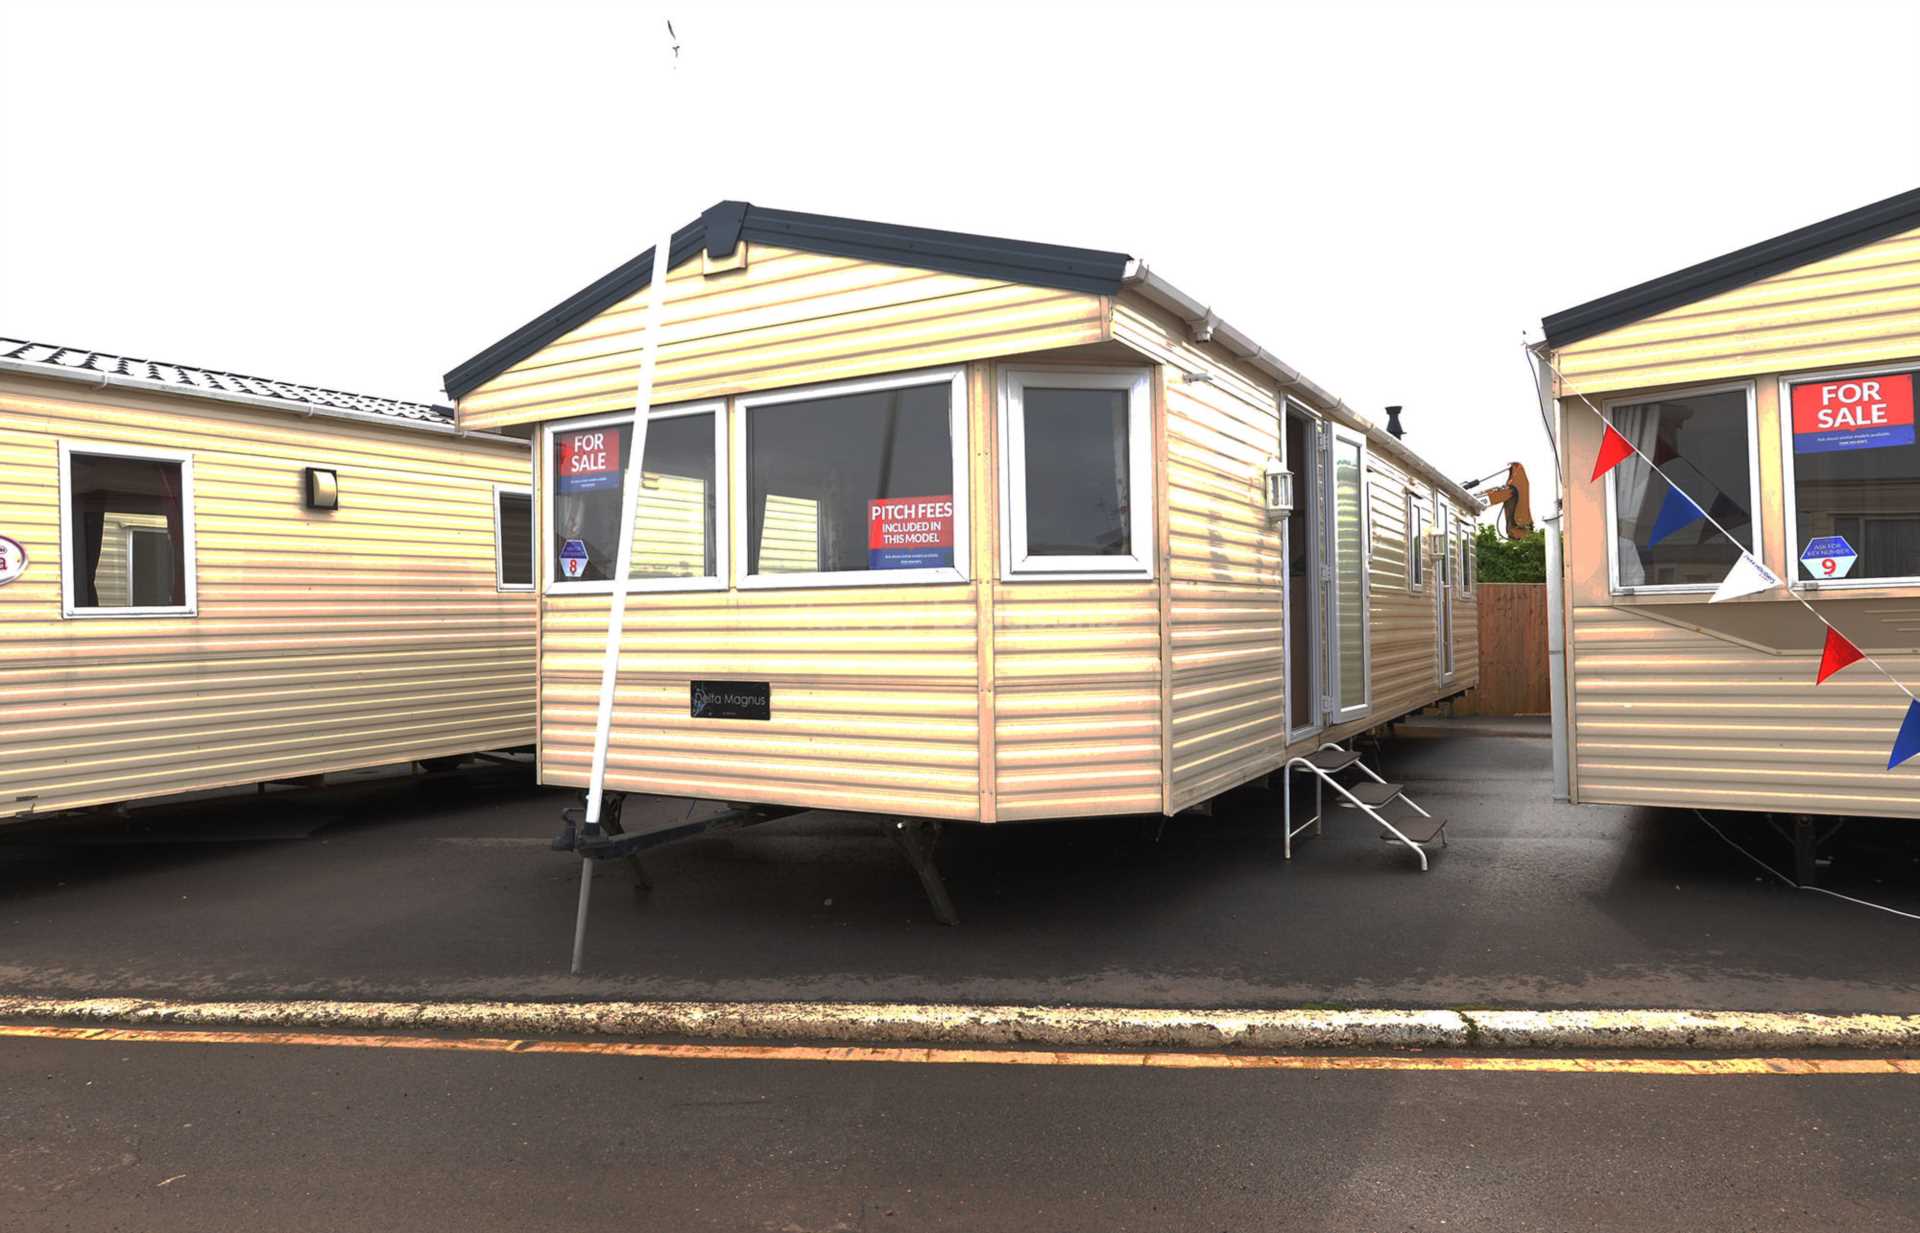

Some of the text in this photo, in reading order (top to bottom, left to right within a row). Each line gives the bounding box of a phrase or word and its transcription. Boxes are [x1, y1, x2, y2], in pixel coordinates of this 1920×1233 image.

[1821, 381, 1881, 406] FOR
[1818, 403, 1888, 429] SALE
[574, 433, 604, 452] FOR
[571, 452, 606, 472] SALE
[872, 502, 952, 520] PITCH FEES
[882, 521, 941, 533] INCLUDED IN
[884, 533, 940, 544] THIS MODEL
[569, 559, 577, 574] 8
[1822, 558, 1837, 575] 9
[724, 693, 766, 707] Magnus
